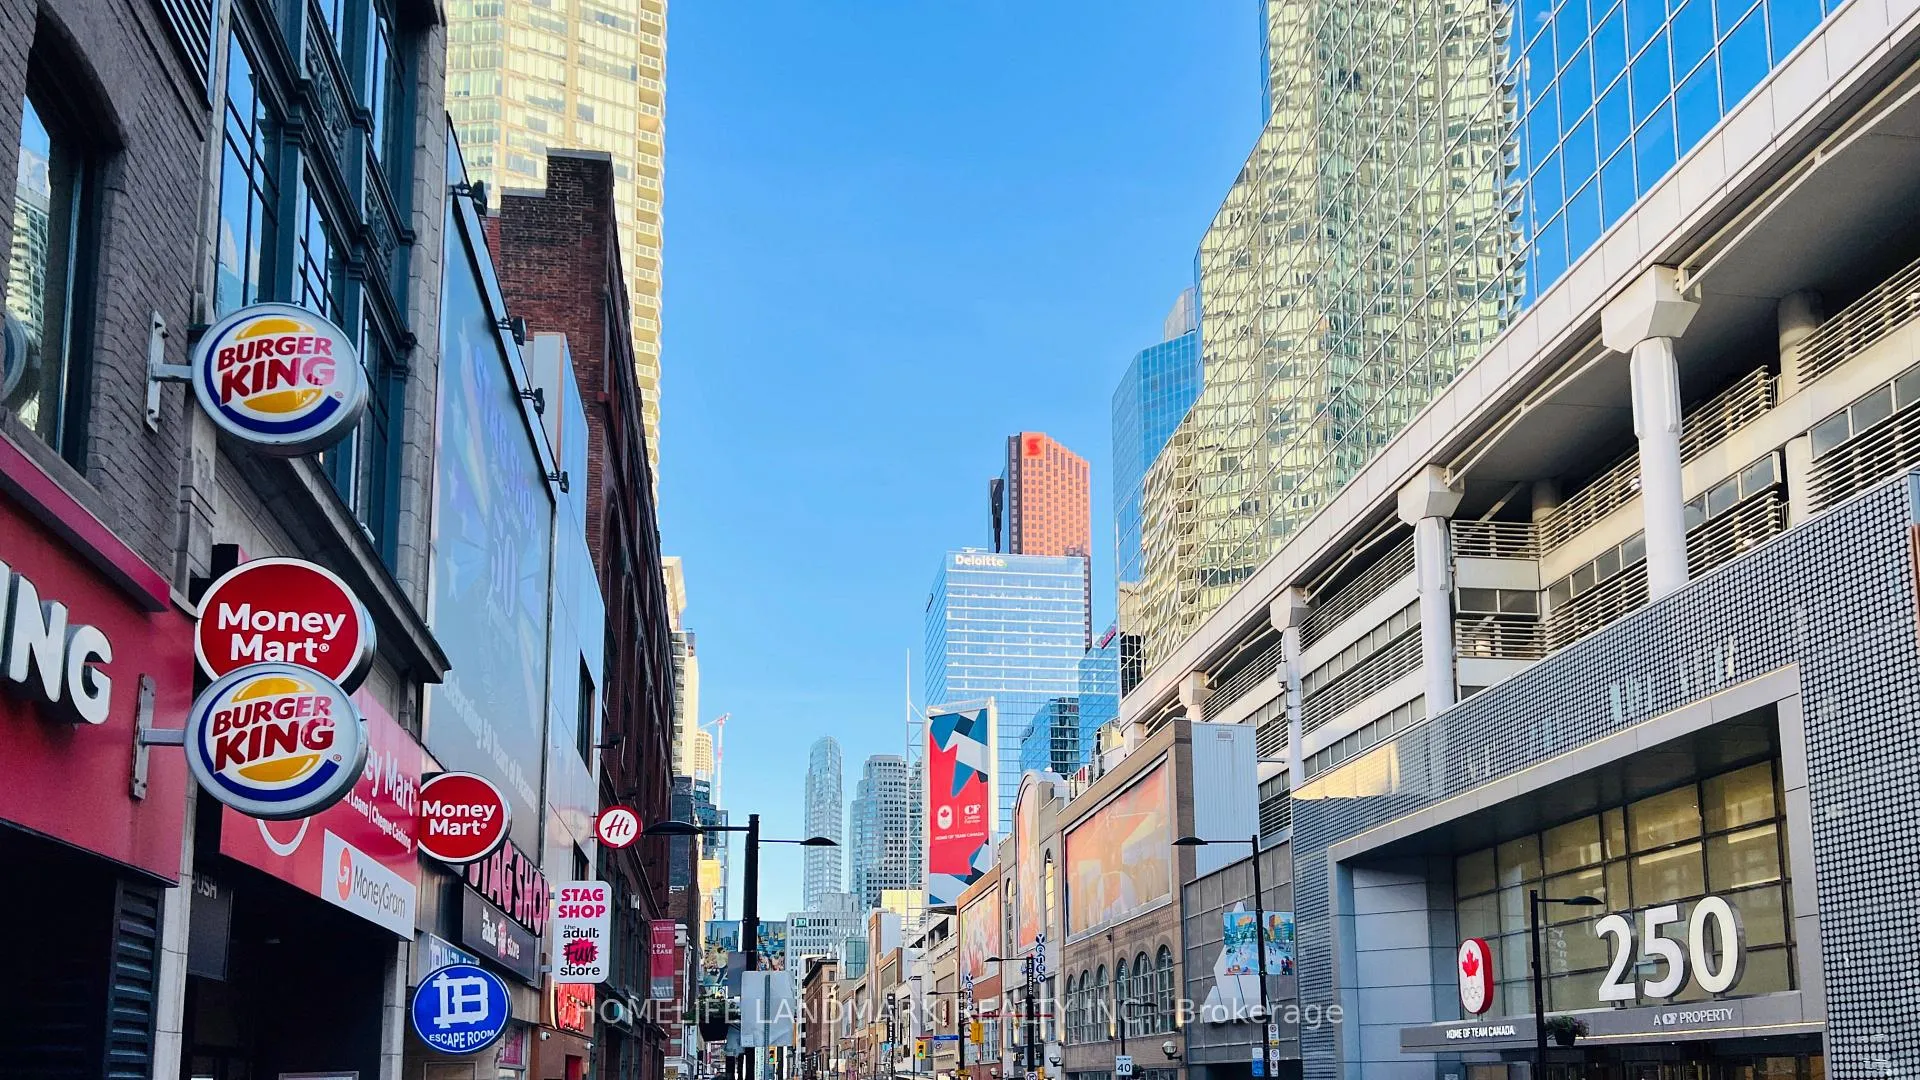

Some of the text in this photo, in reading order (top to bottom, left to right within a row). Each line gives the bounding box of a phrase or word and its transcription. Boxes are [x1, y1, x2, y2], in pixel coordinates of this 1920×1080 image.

[217, 337, 333, 371] BURGER
[220, 357, 336, 405] KING
[218, 602, 346, 640] Money
[211, 696, 332, 737] BURGER
[215, 718, 335, 772] KING
[422, 800, 496, 822] Money
[604, 813, 631, 838] Hi
[353, 866, 406, 919] MoneyGram
[515, 852, 550, 937] SHOP
[561, 888, 604, 902] STAG
[558, 905, 606, 919] SHOP
[563, 928, 600, 938] adult
[564, 941, 597, 966] Fun
[1595, 896, 1742, 1001] 250
[560, 965, 601, 976] store
[1654, 1014, 1661, 1026] A
[1680, 1008, 1734, 1024] PROPERTY
[429, 1029, 495, 1048] ESCAPE ROOM
[1446, 1025, 1515, 1039] HOME OF TEAM CANADA
[1117, 1063, 1131, 1072] 40
